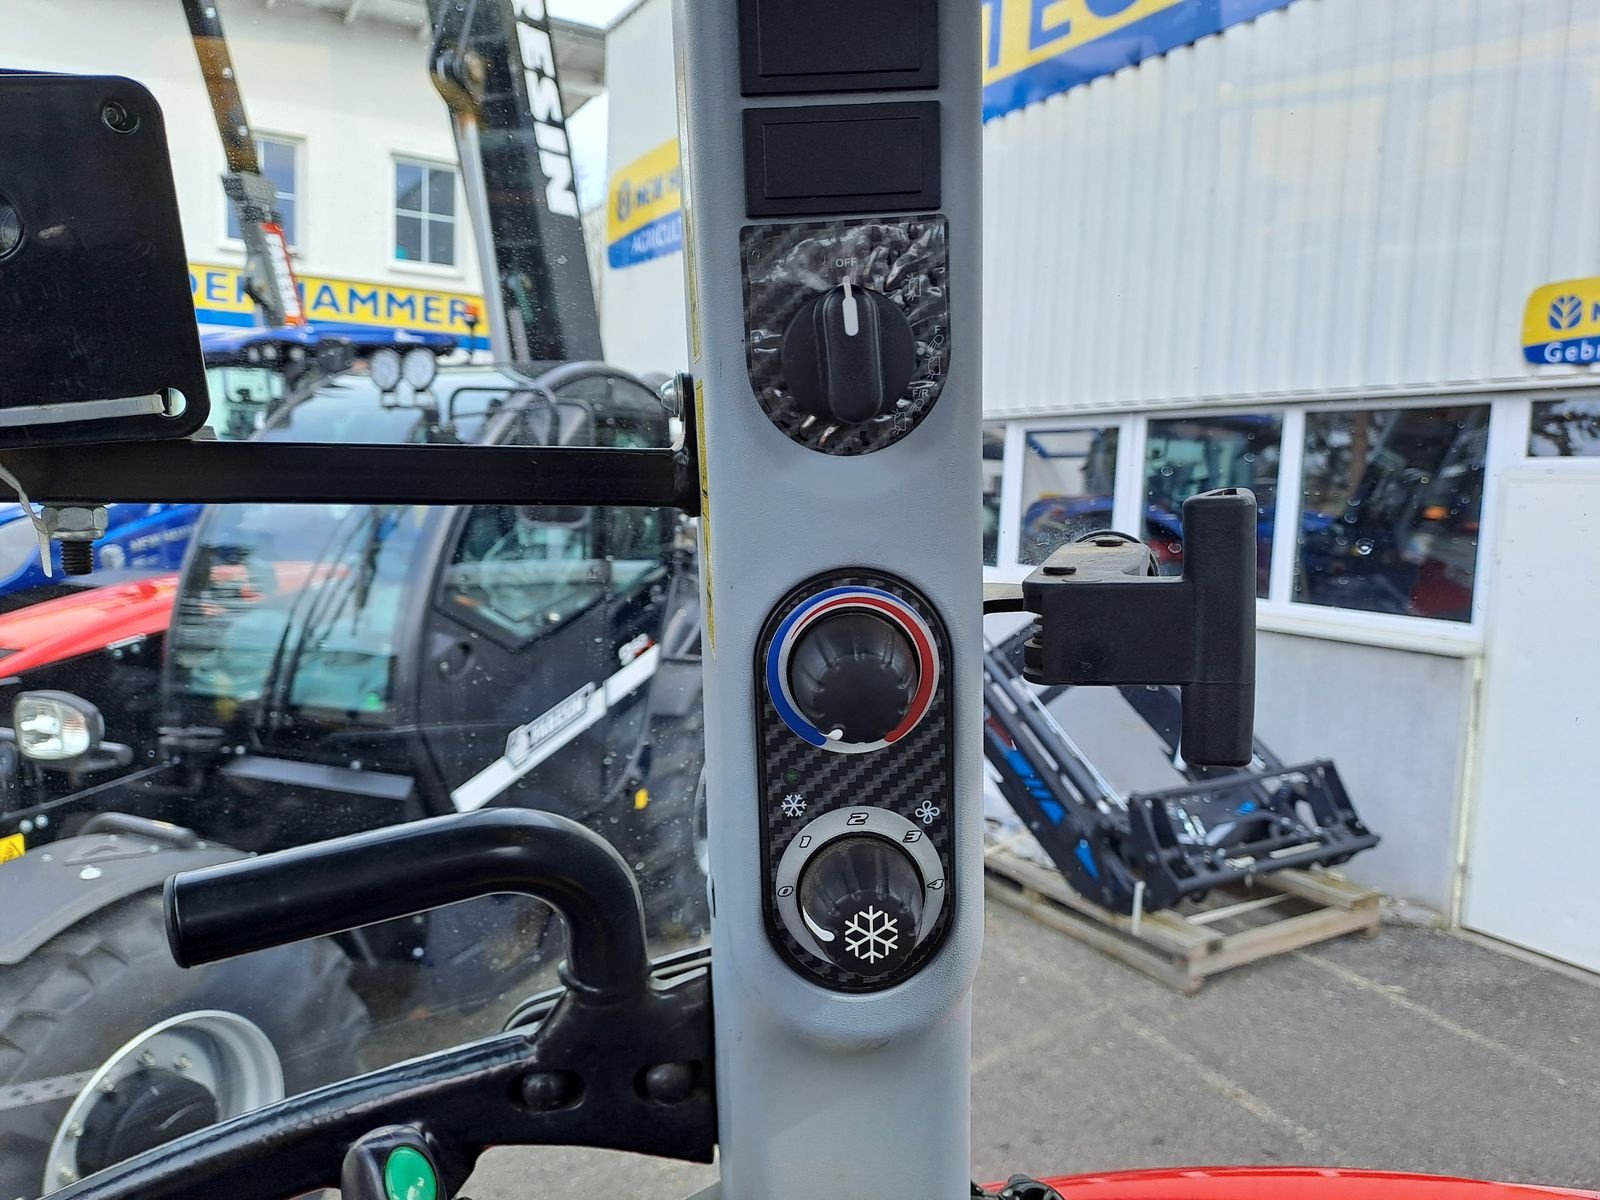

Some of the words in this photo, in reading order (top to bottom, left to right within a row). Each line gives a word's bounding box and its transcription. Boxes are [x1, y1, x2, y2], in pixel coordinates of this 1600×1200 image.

[835, 257, 857, 268] OFF
[934, 325, 941, 334] F
[912, 388, 929, 398] F/R
[847, 812, 869, 826] 2
[799, 835, 812, 849] 1
[902, 829, 923, 843] 3
[927, 878, 945, 890] 4
[777, 885, 794, 898] 0
